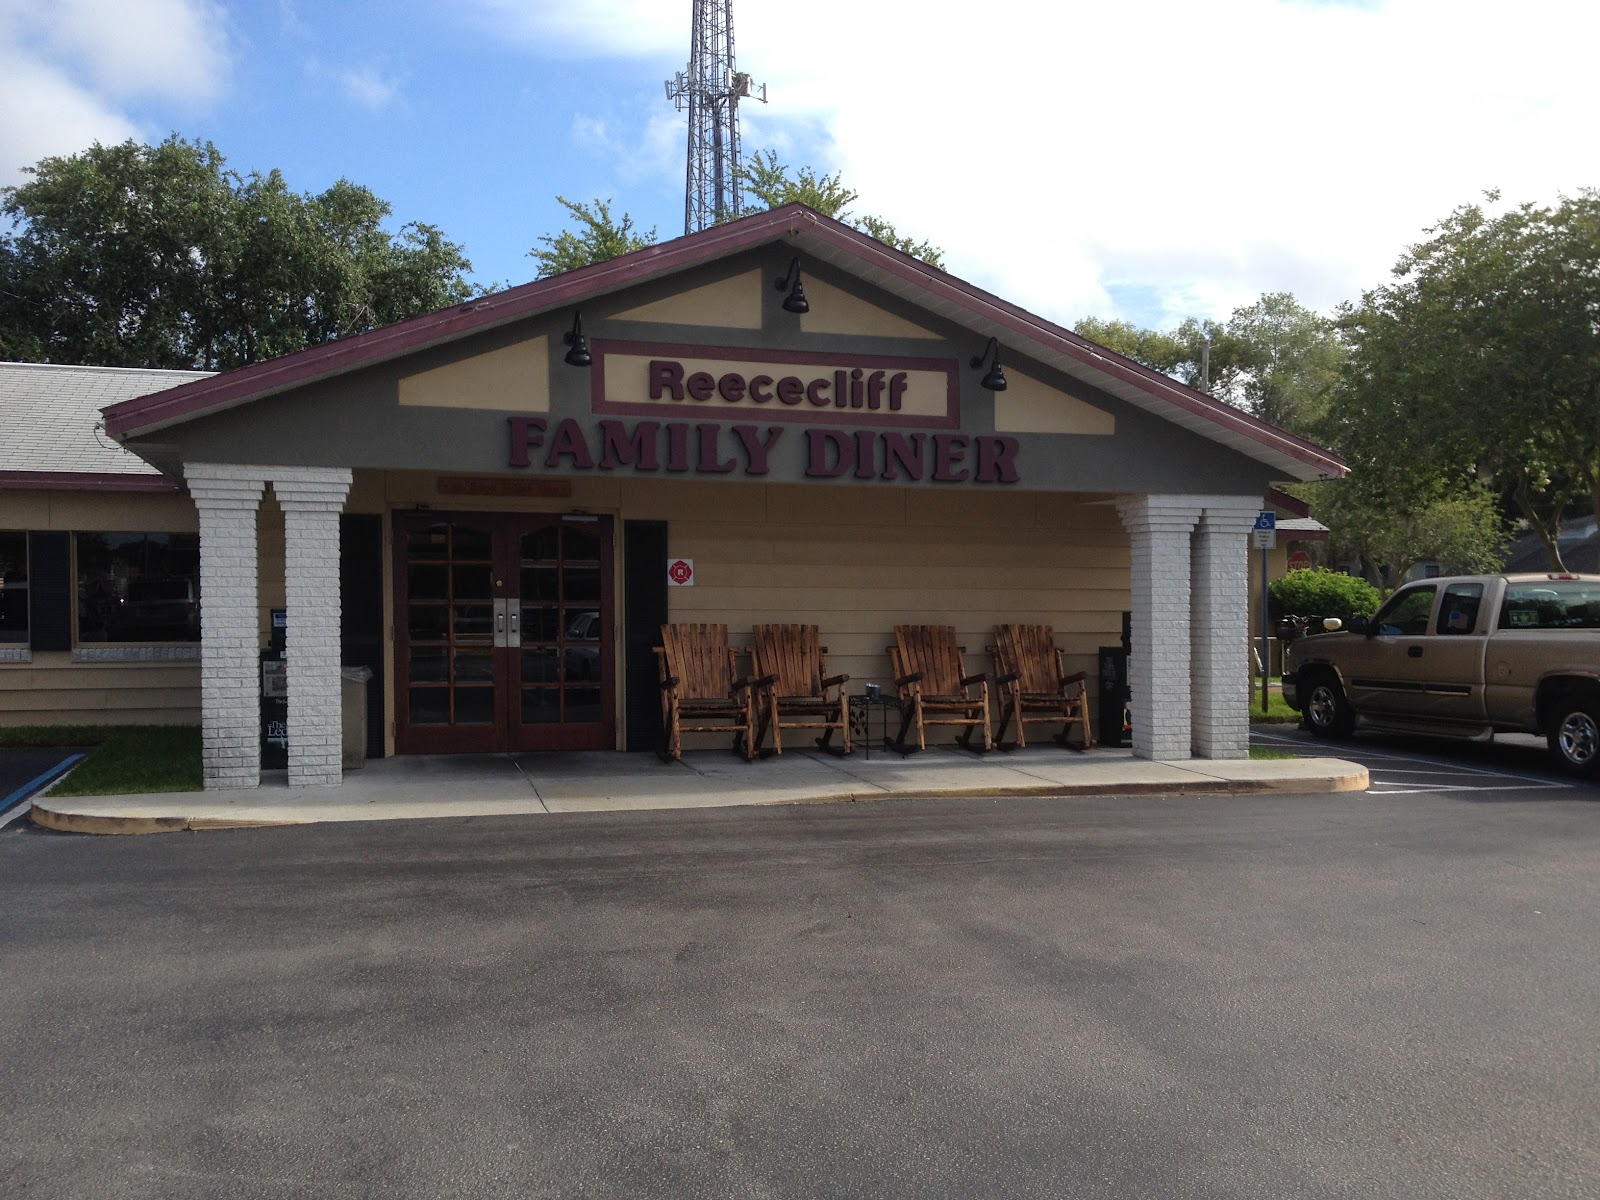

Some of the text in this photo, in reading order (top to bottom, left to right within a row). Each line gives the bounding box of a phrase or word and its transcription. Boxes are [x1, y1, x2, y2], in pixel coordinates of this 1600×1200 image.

[649, 360, 908, 411] Reececliff
[507, 415, 1021, 483] FAMILY DINER
[1289, 561, 1308, 569] STOP
